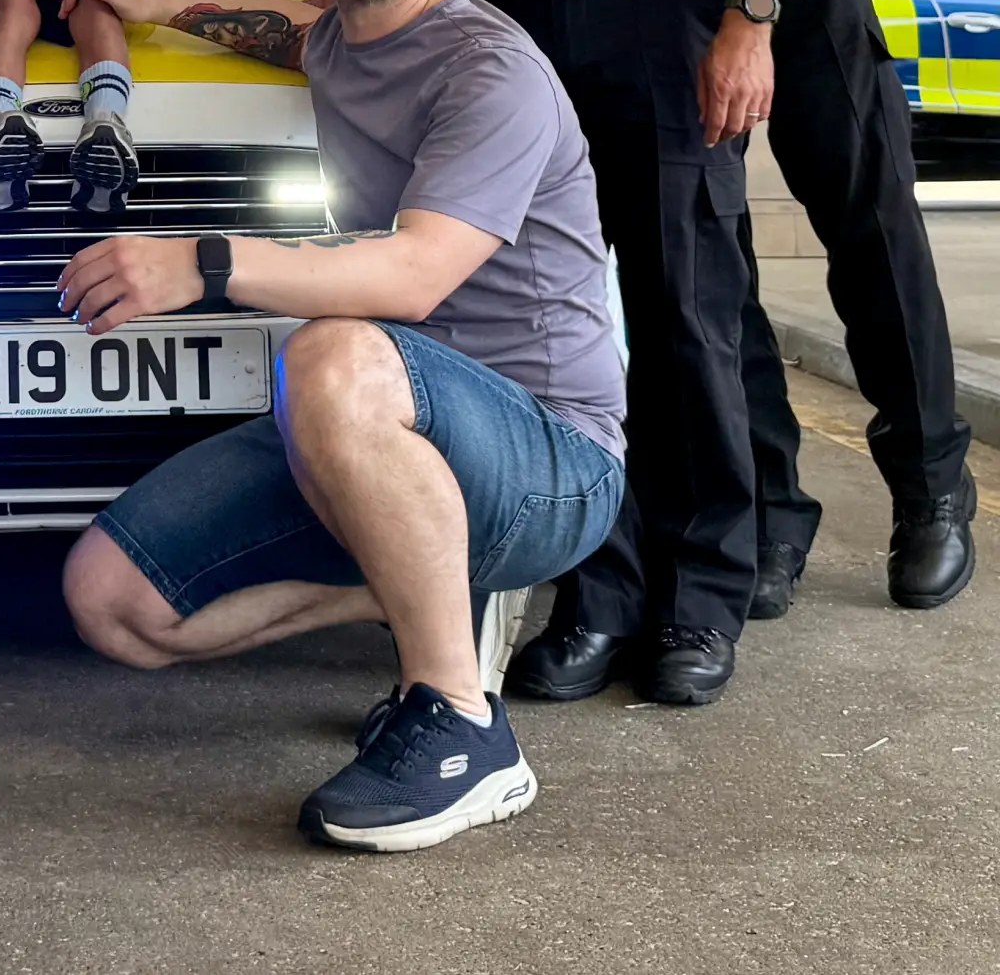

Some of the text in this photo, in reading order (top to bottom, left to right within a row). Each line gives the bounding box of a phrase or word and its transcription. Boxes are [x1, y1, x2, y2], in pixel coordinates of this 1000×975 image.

[37, 100, 82, 114] Ford
[90, 336, 223, 402] ONT
[69, 406, 104, 415] CARDIFF
